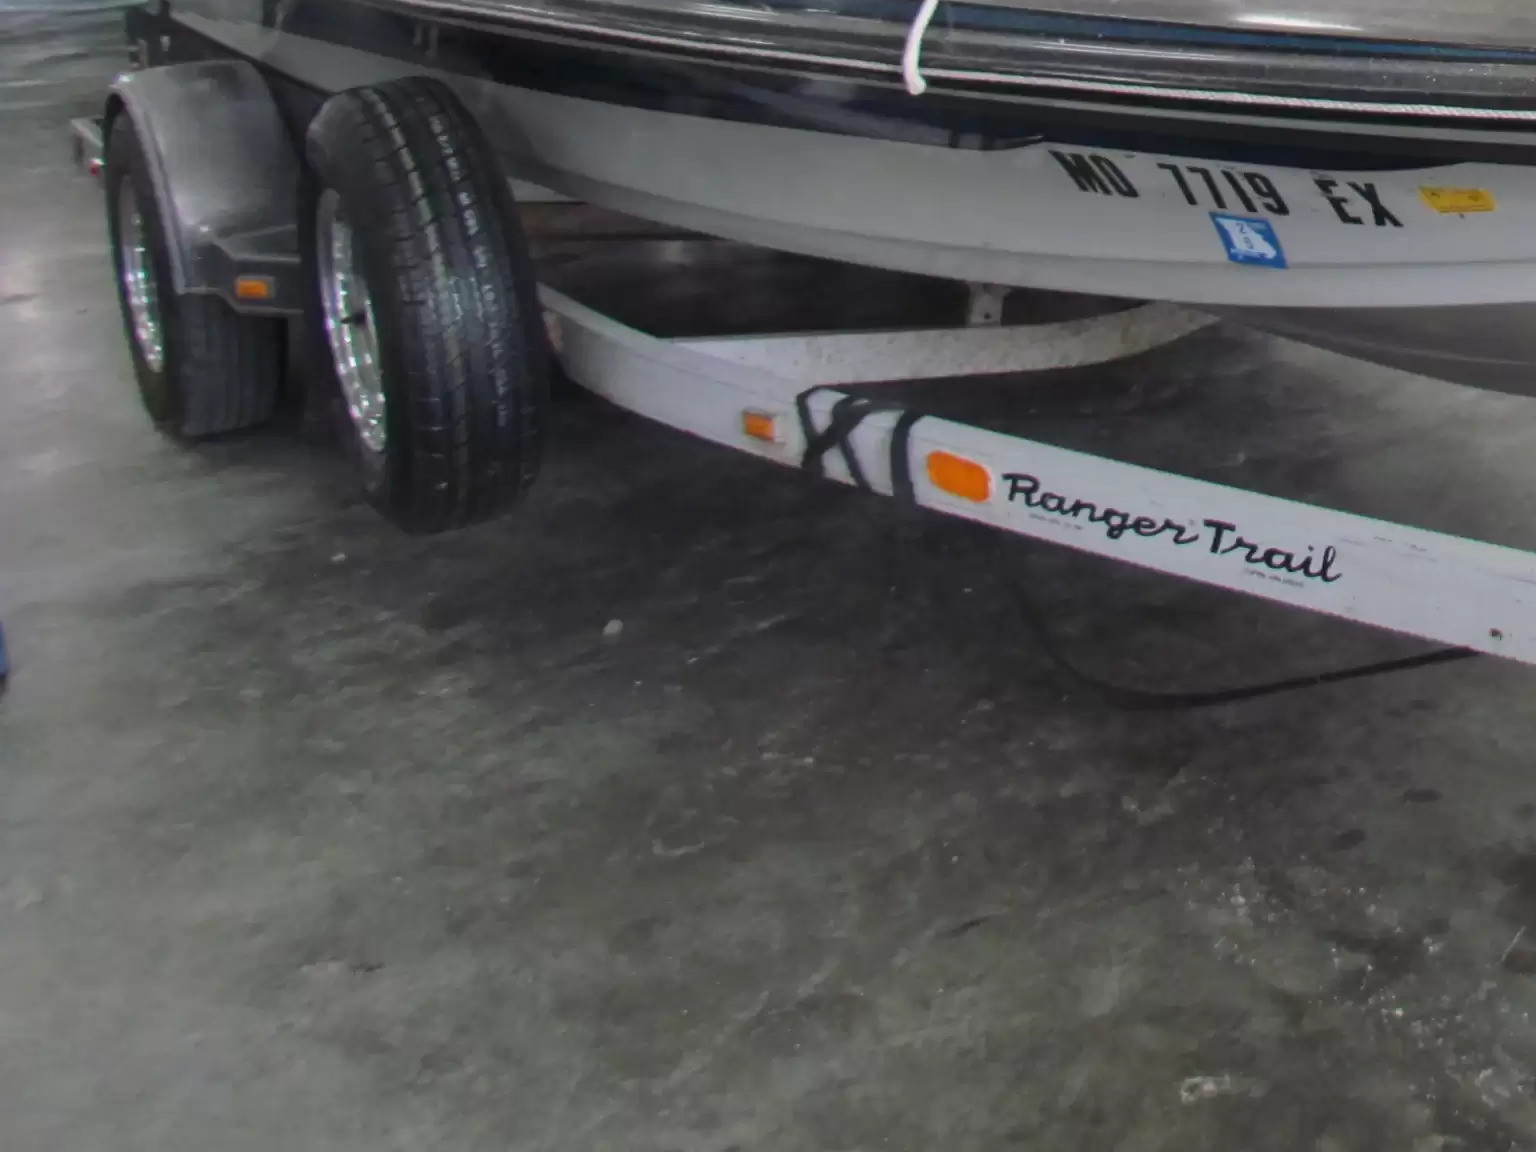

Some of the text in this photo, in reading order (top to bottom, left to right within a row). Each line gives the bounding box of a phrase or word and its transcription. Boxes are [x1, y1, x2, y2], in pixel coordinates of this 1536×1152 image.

[1157, 162, 1290, 216] 7719
[1313, 176, 1404, 228] EX
[1001, 472, 1343, 584] Ranger Trail
